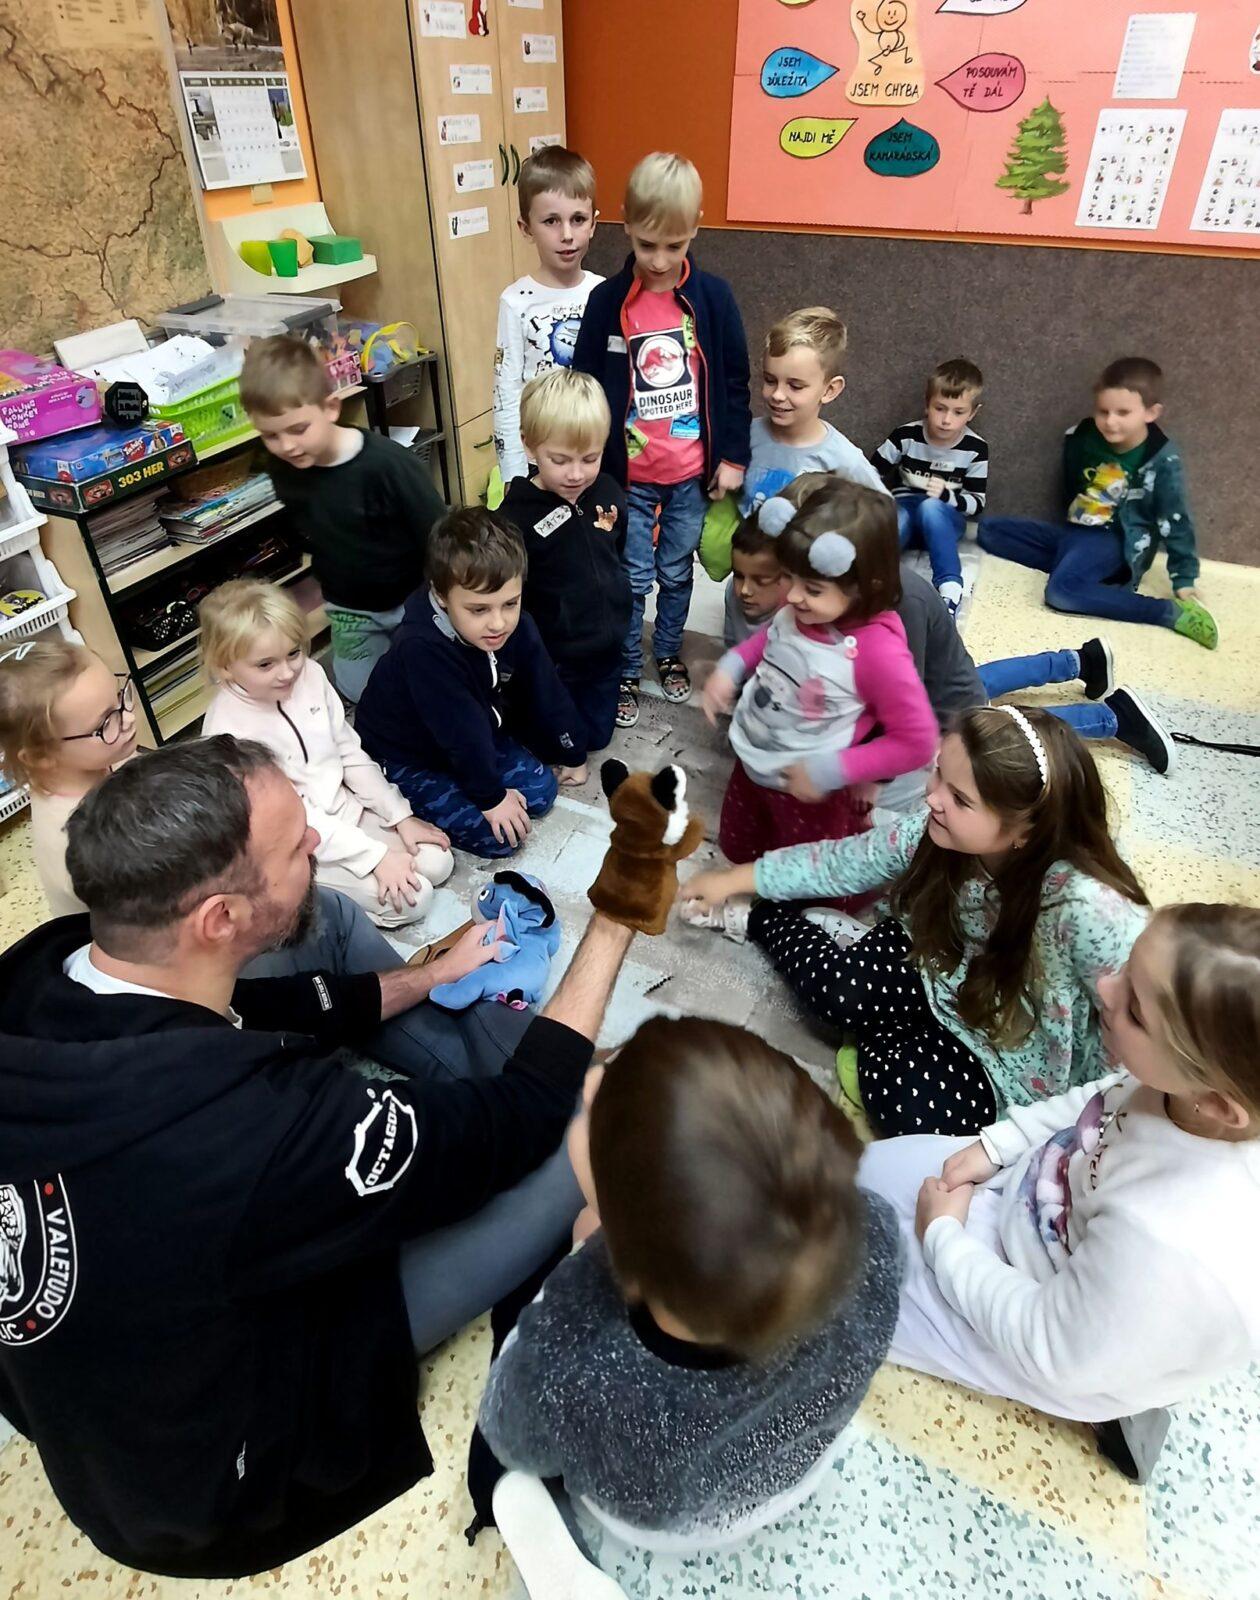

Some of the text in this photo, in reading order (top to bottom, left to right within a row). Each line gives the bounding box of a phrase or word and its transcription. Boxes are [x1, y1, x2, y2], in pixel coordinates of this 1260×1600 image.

[778, 56, 802, 67] JSEM
[966, 60, 1018, 79] POSOUVÁM
[766, 70, 810, 87] DŮLEŽITÁ
[849, 83, 920, 98] JSEM CHYBA
[984, 81, 1003, 97] DÁL
[789, 129, 836, 144] NAJDI MĚ
[888, 131, 913, 144] JSEM
[639, 388, 693, 408] DINOSAUR
[2, 399, 36, 416] FALLING
[5, 407, 38, 425] MONKEY
[640, 400, 693, 417] SPOTTED HERE
[118, 461, 165, 488] 303 HER
[35, 1207, 71, 1320] VALETUDO
